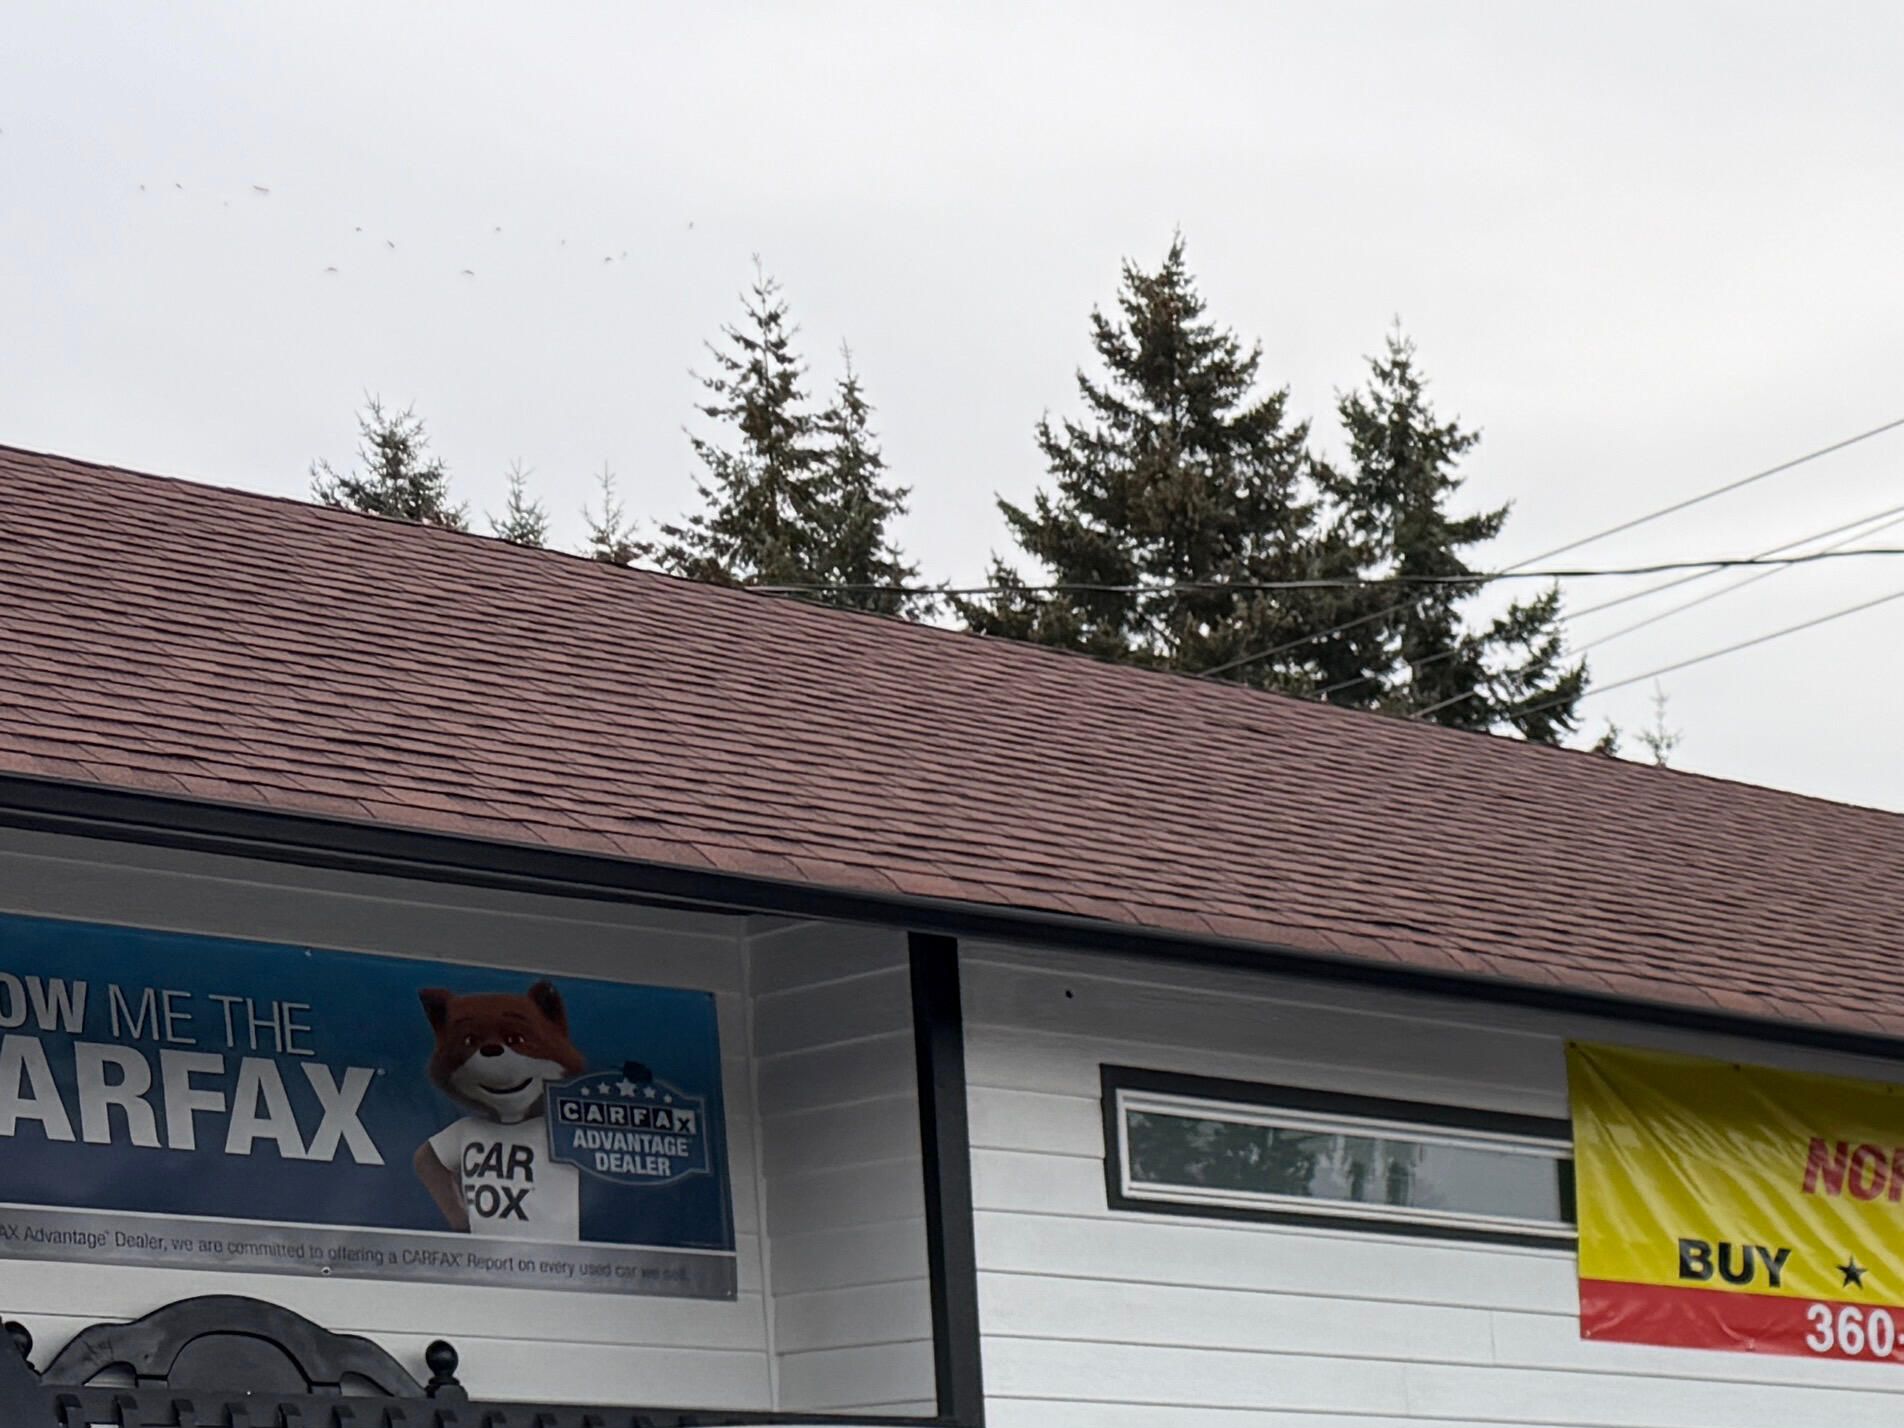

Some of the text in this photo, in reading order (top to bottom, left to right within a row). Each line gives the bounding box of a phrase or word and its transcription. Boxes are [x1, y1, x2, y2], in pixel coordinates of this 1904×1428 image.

[108, 984, 197, 1044] ME
[208, 994, 315, 1056] THE
[0, 1034, 385, 1166] ARFAX
[561, 1100, 695, 1134] CARFAX
[463, 1141, 534, 1183] CAR
[573, 1129, 689, 1157] ADVANTAGE
[595, 1152, 671, 1177] DEALER
[24, 1226, 107, 1249] Advantage
[115, 1231, 168, 1251] Dealer,
[172, 1238, 193, 1251] we
[199, 1240, 222, 1253] are
[224, 1241, 304, 1258] committed
[309, 1246, 324, 1259] to
[328, 1248, 384, 1265] offering
[388, 1252, 399, 1263] a
[402, 1249, 459, 1267] CARFAX
[467, 1254, 514, 1272] Report
[518, 1260, 535, 1272] on
[540, 1261, 575, 1278] every
[579, 1264, 611, 1277] used
[1678, 1239, 1791, 1287] BUY
